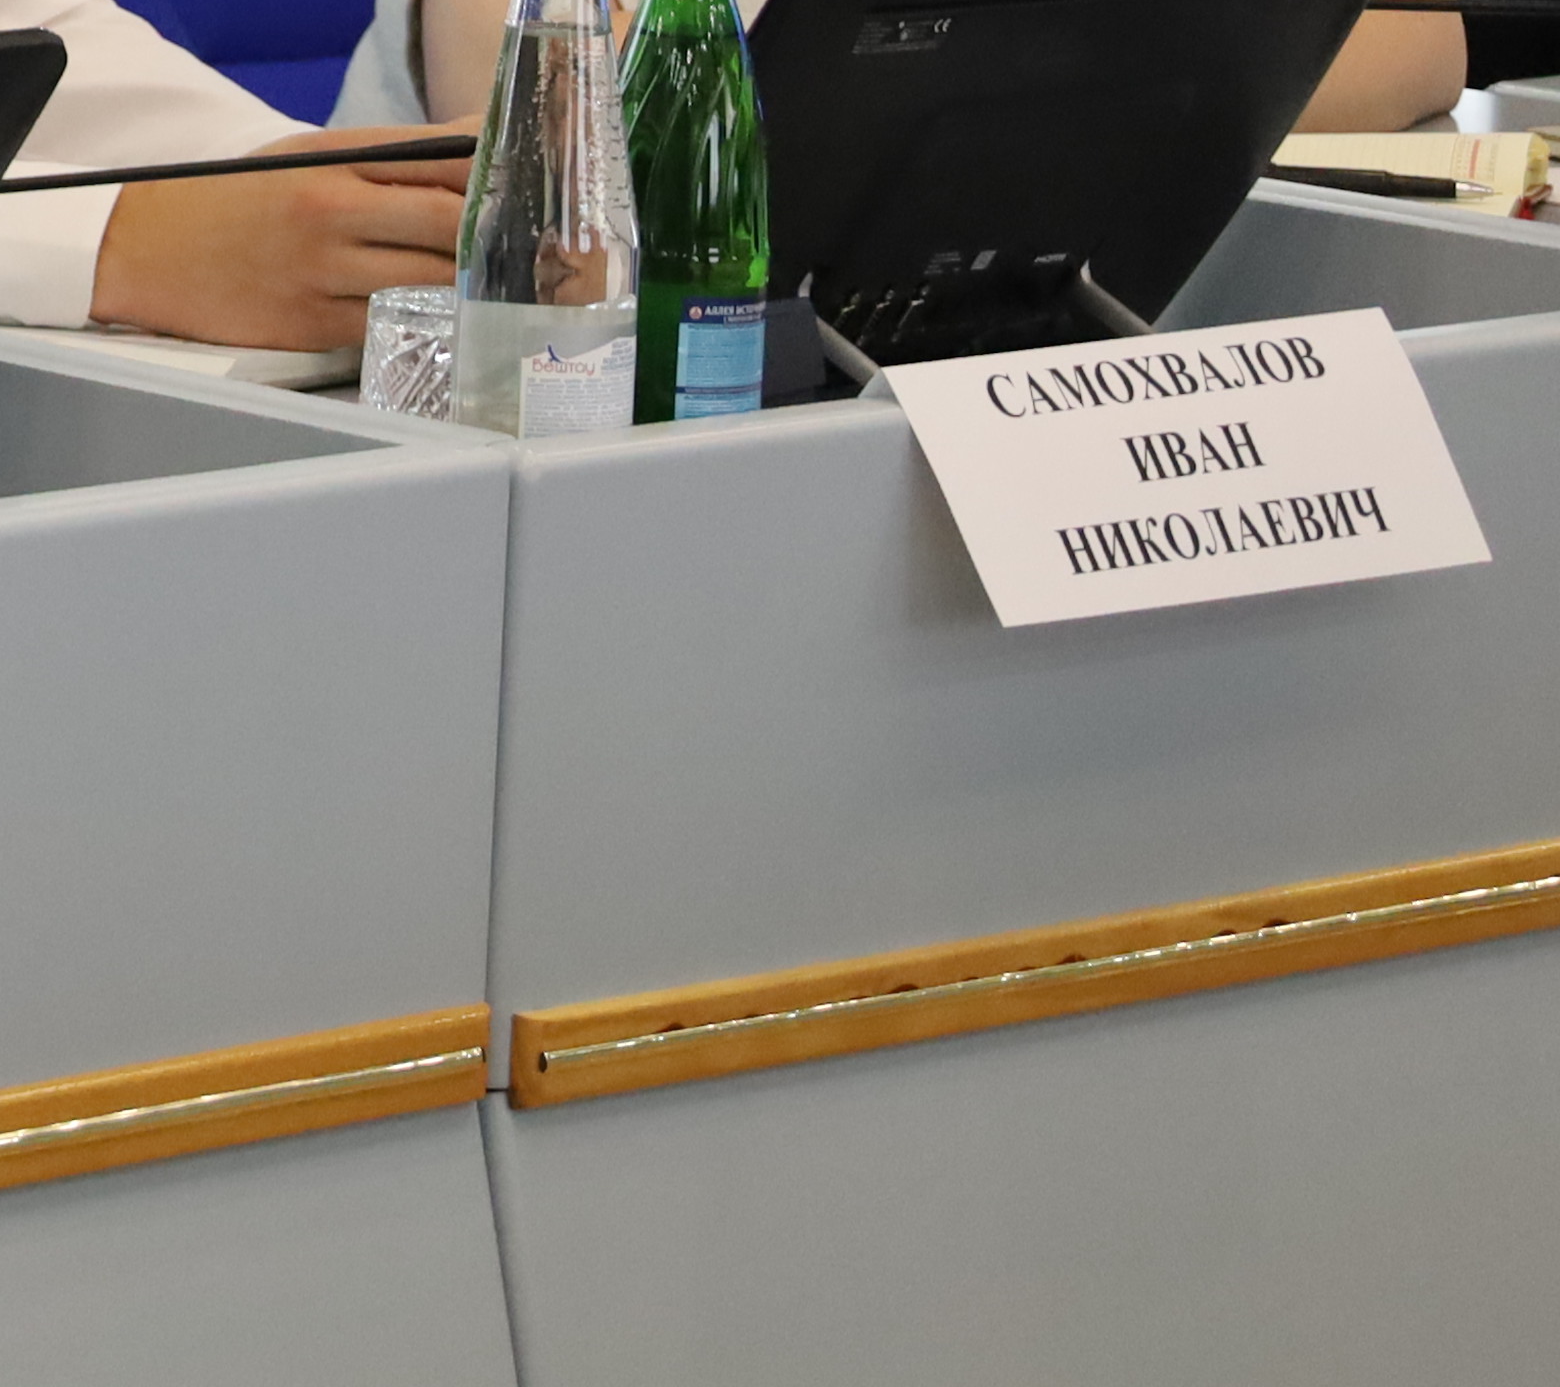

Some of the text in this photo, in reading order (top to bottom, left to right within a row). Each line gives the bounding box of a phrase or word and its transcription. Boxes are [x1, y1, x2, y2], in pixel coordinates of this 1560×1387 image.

[984, 335, 1327, 419] САМОХВАЛОВ
[1123, 422, 1266, 483] ИВАН
[1055, 486, 1391, 577] НИКОЛАЕВИЧ
